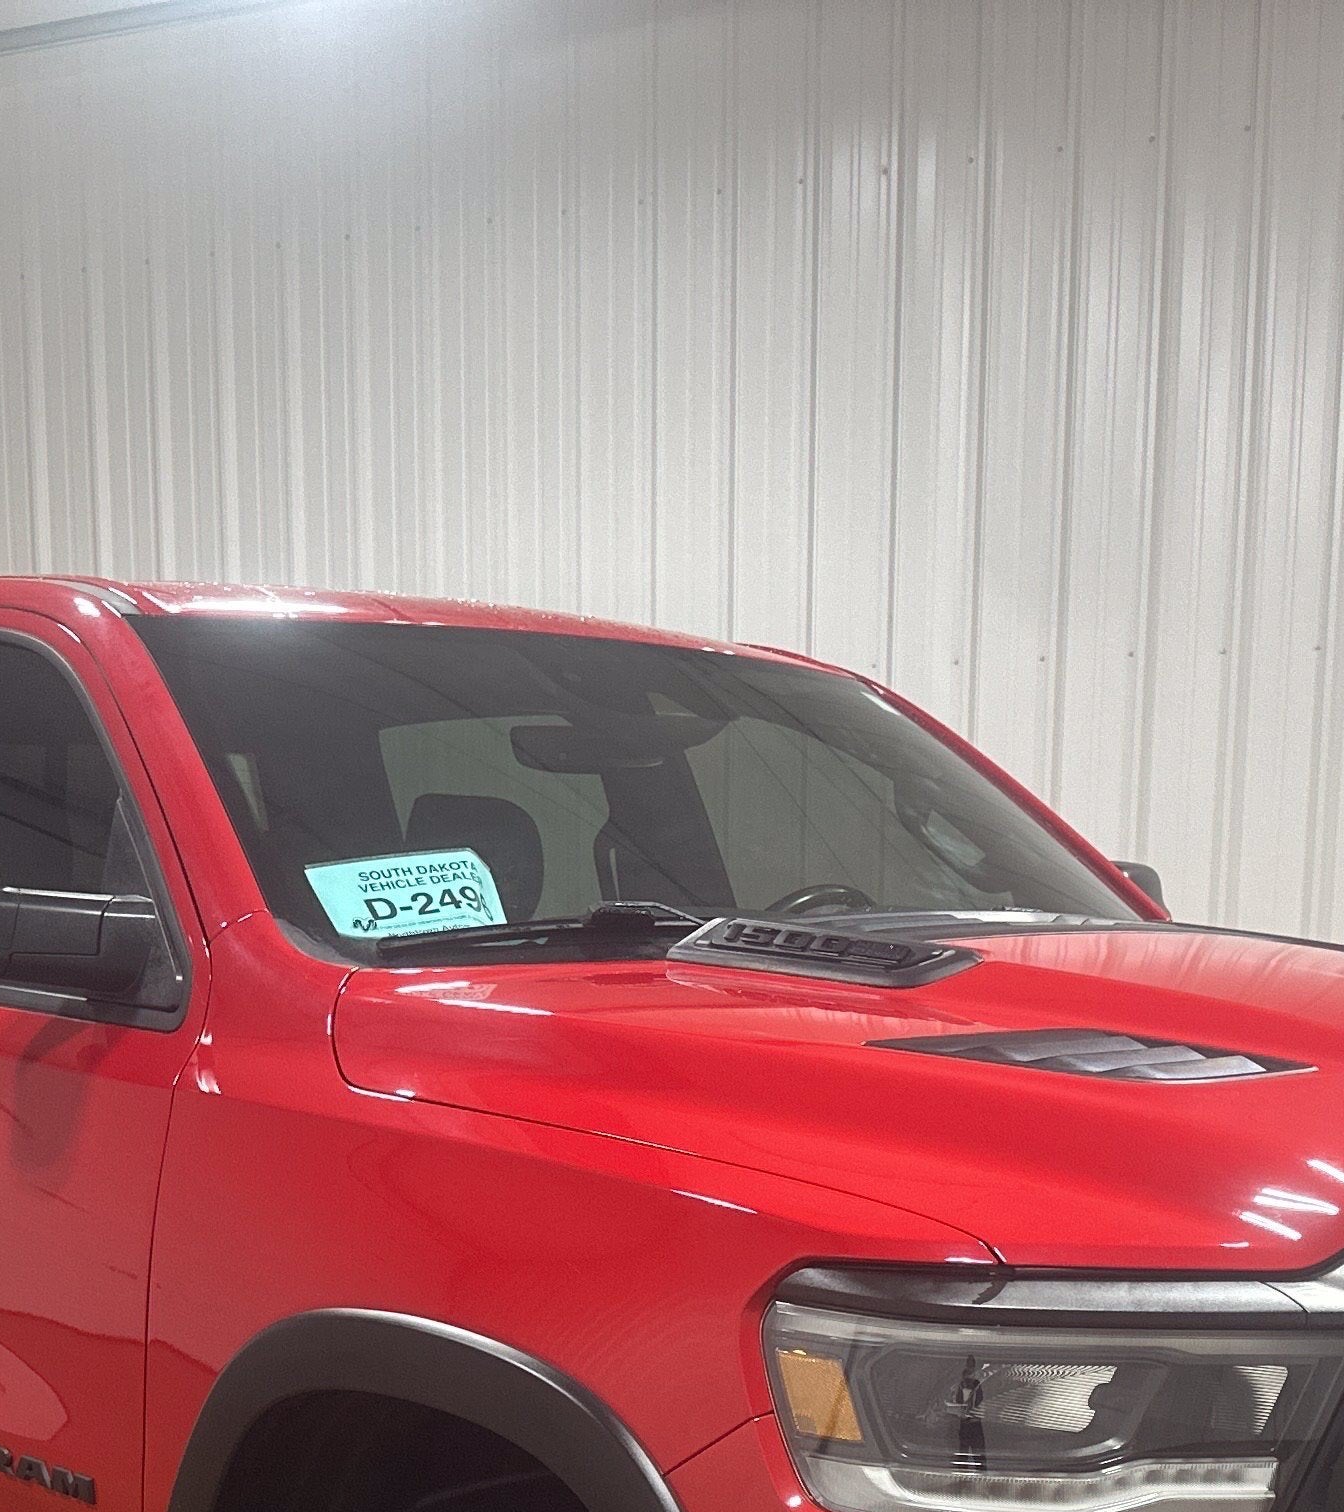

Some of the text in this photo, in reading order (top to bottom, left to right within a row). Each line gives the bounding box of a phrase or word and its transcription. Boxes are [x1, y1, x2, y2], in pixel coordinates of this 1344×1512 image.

[358, 860, 478, 883] SOUTH DAKOTA
[357, 876, 428, 894] VEHICLE
[723, 919, 853, 956] 1500
